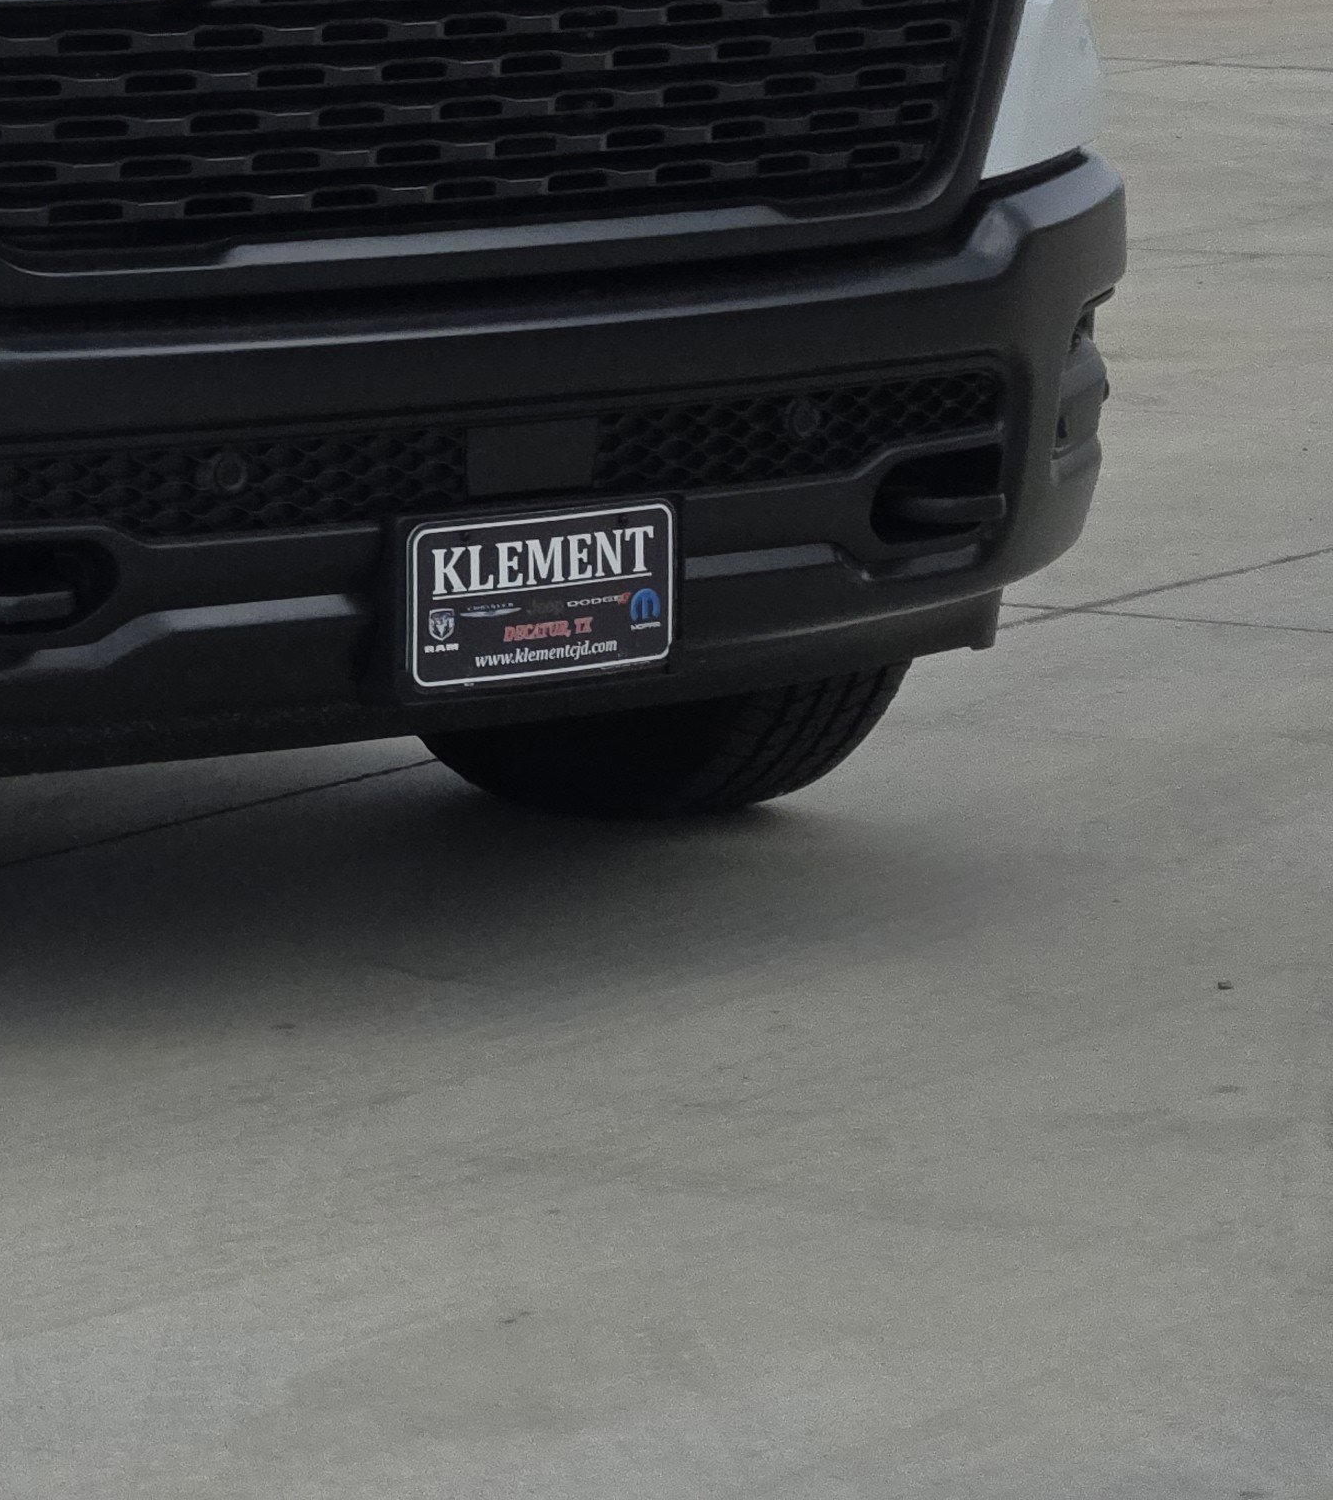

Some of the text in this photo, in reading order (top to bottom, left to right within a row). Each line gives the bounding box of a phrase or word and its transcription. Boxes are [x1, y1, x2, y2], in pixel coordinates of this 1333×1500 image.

[432, 525, 654, 595] KLEMENT
[567, 594, 623, 608] DODGE
[503, 616, 594, 642] DECATUR, TX
[424, 642, 459, 654] RAM
[474, 639, 618, 668] www.klementcjd.com
